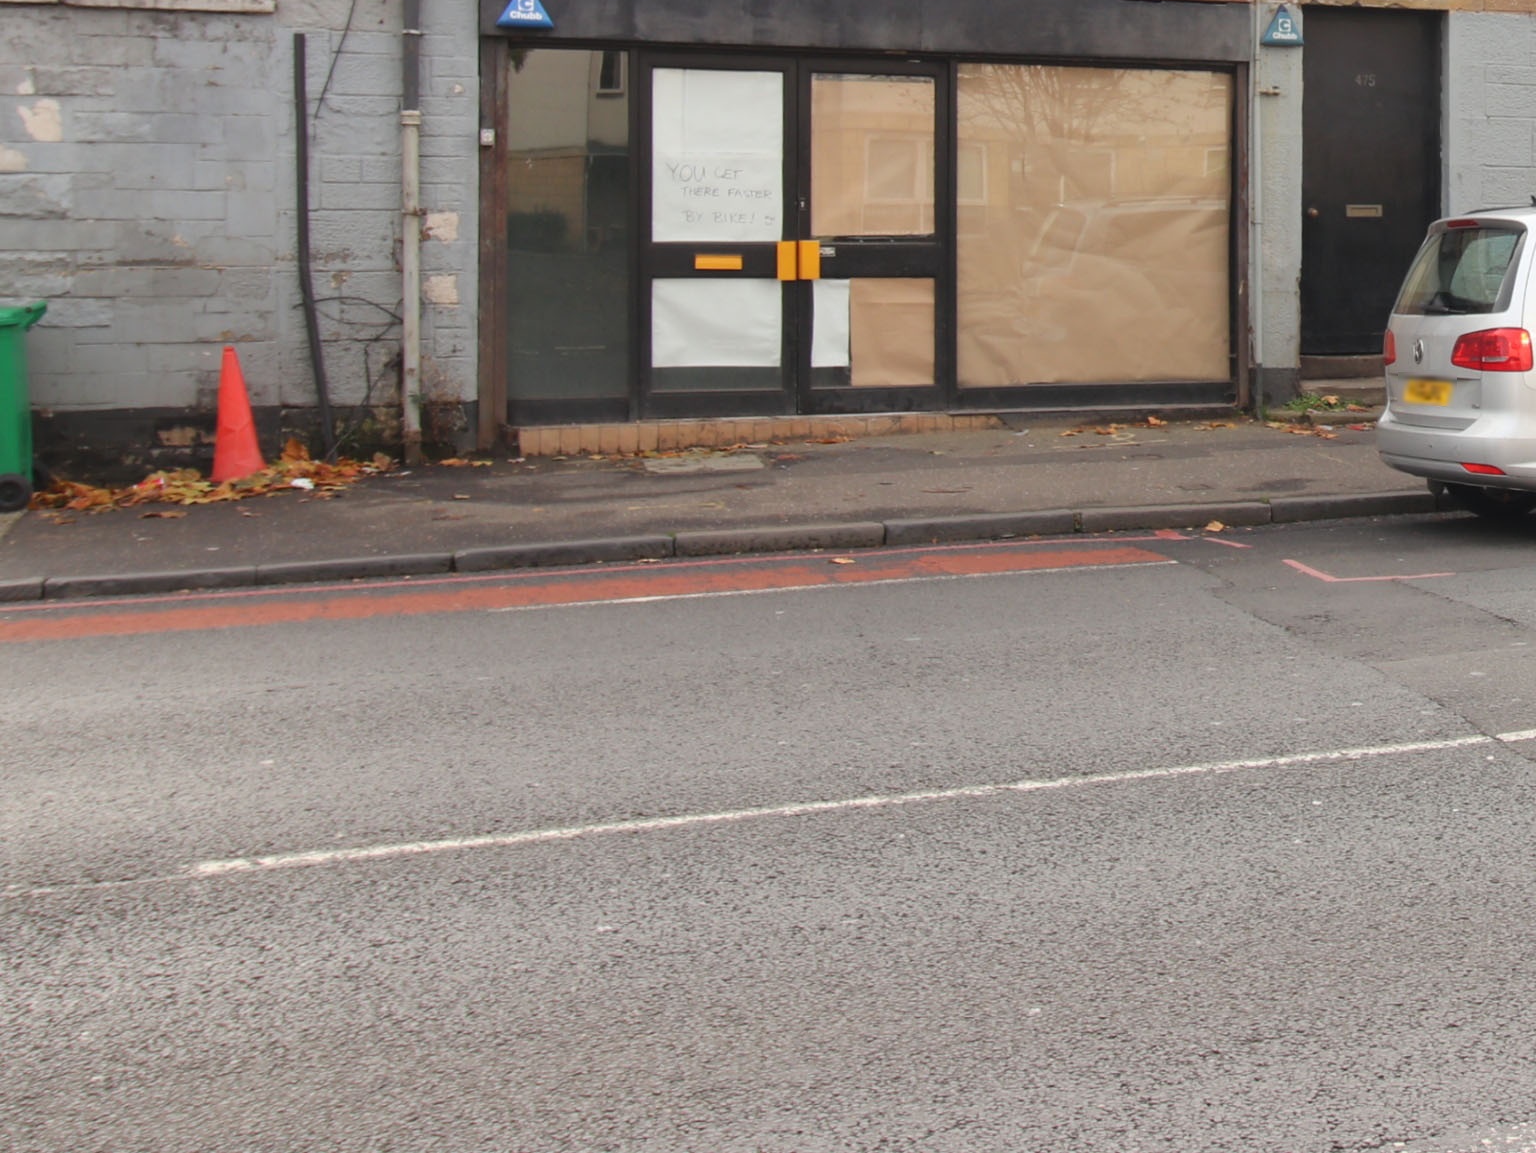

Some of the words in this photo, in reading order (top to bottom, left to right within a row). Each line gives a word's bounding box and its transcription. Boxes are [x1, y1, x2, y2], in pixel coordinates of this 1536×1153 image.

[509, 10, 543, 21] Chubb
[1272, 31, 1298, 41] Chubb
[1355, 74, 1377, 87] 475
[665, 161, 706, 182] YOU
[680, 186, 720, 198] THERE
[727, 188, 773, 199] FASTER
[681, 209, 703, 224] BY
